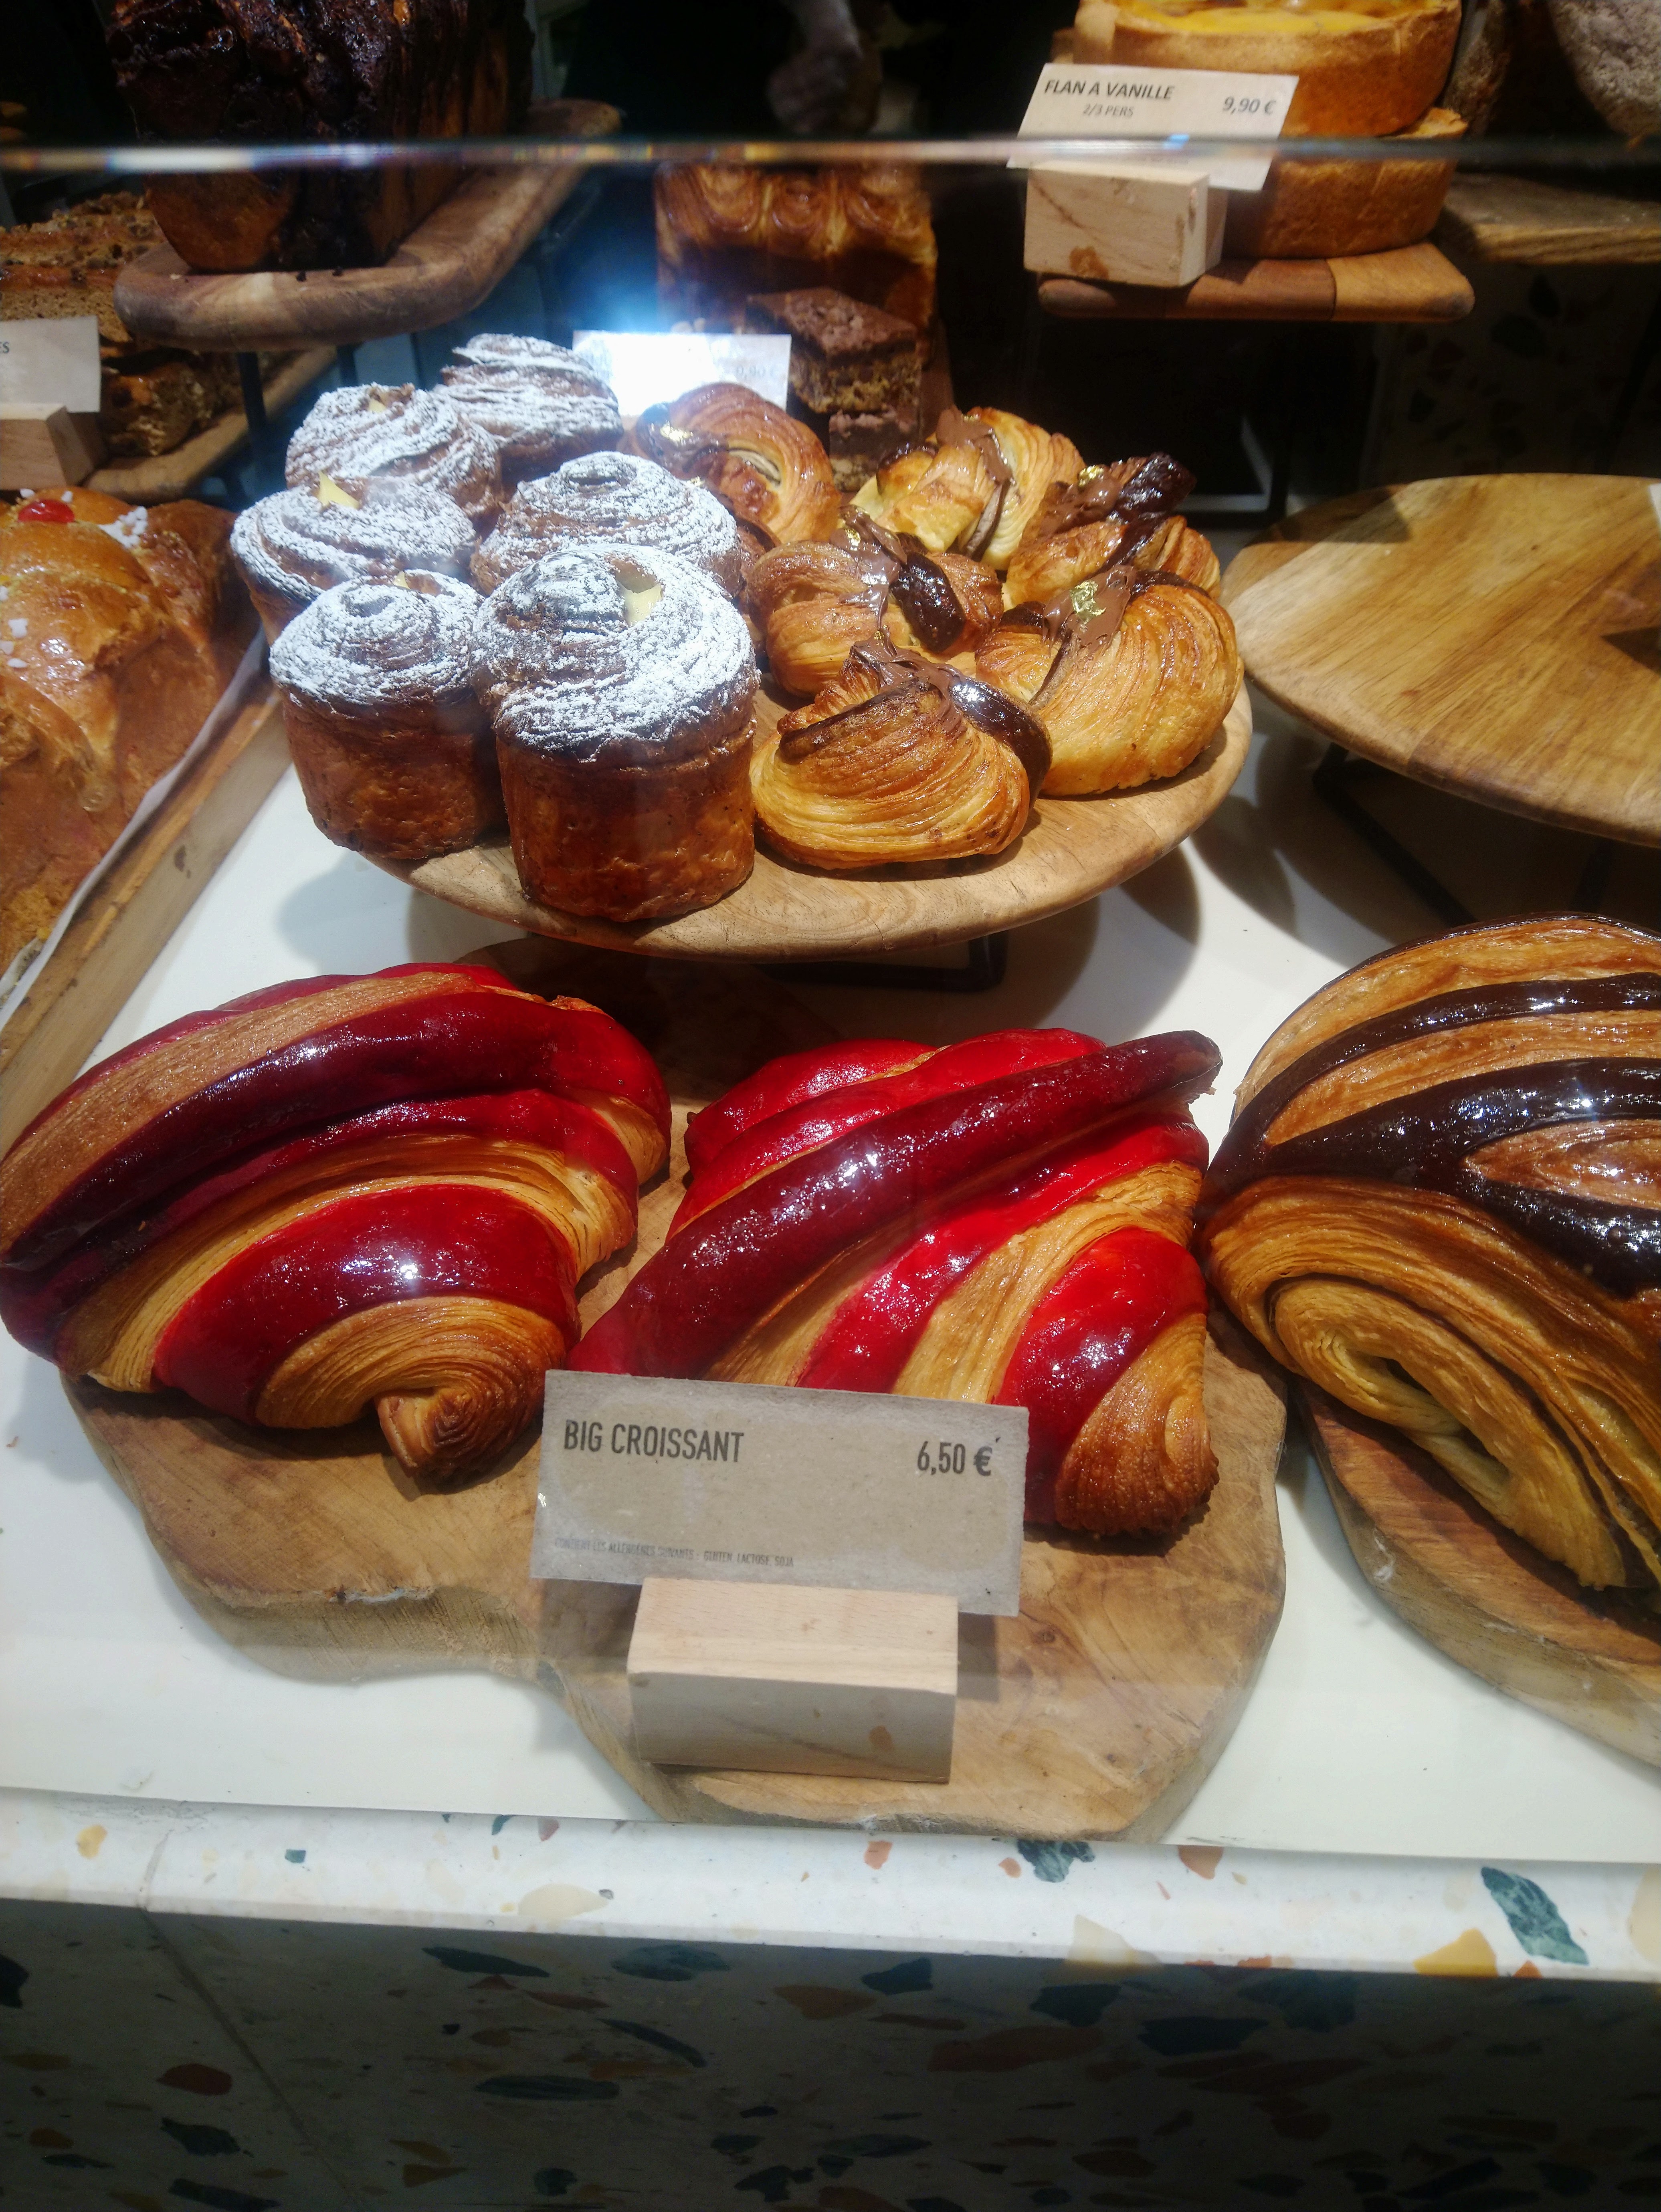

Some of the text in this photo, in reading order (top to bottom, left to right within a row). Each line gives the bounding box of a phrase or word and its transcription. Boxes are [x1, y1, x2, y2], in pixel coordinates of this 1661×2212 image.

[1045, 80, 1175, 99] FLAN A VANILLE
[1083, 103, 1134, 117] 2/3 PERS
[1223, 96, 1277, 115] 9,90 €
[564, 1419, 745, 1462] BIG CROISSANT
[917, 1441, 992, 1476] 6,50 €
[775, 1555, 794, 1567] SOJA
